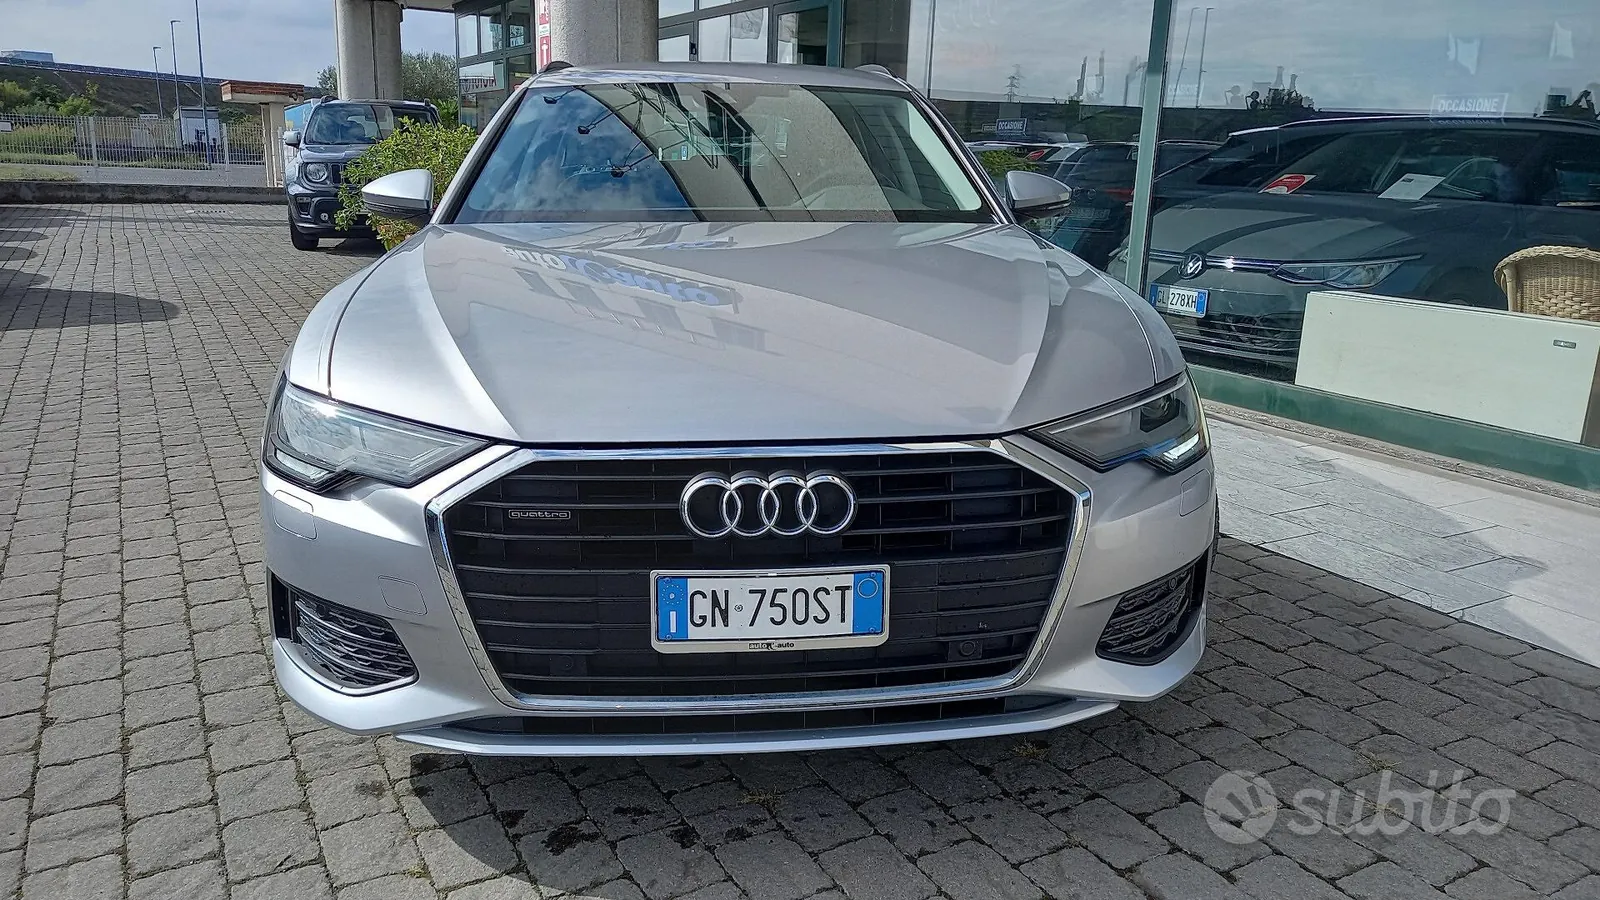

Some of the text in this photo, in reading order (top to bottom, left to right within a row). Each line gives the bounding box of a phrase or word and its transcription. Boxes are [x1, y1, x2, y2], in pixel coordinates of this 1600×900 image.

[1438, 97, 1499, 112] OCCASIONE
[1157, 290, 1167, 305] GL
[1169, 292, 1197, 309] 278XH
[511, 511, 568, 519] quattro
[689, 589, 730, 628] GN
[748, 585, 853, 628] 750ST
